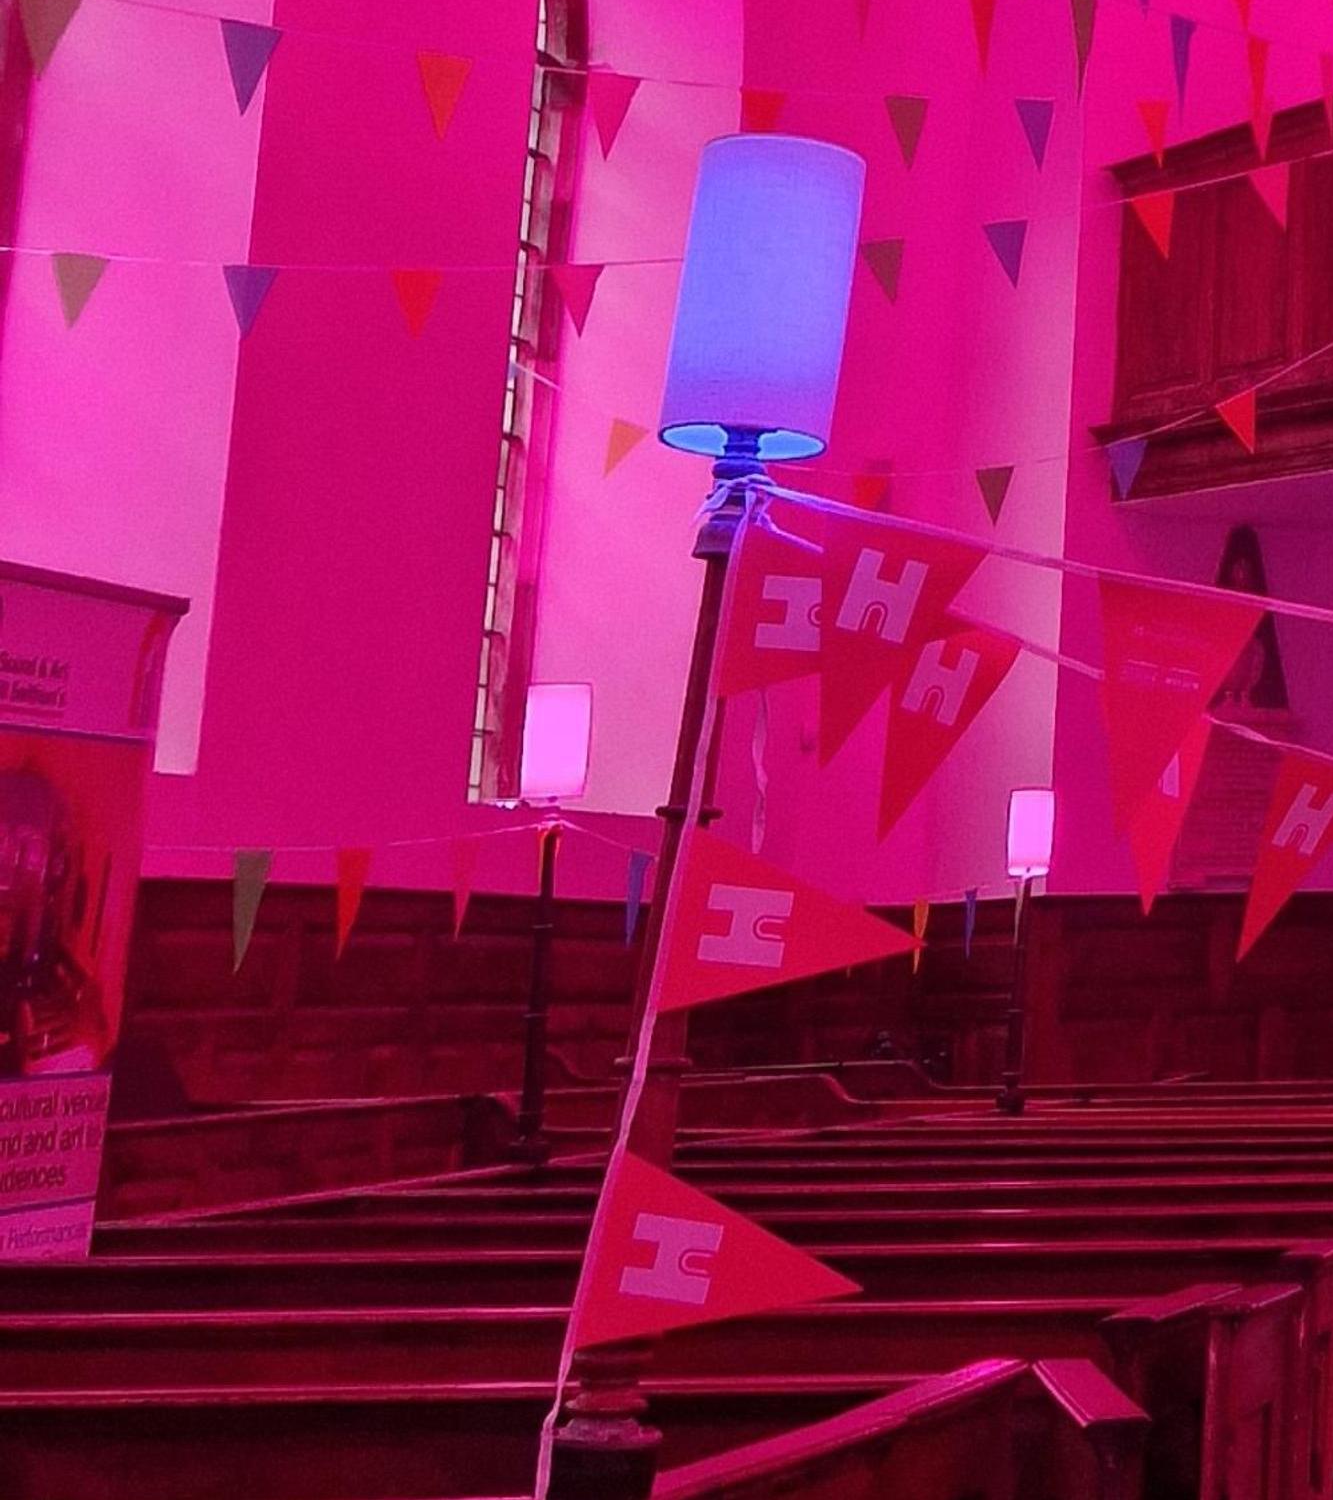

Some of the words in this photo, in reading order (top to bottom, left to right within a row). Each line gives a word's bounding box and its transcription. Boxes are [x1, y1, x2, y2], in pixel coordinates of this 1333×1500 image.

[836, 549, 929, 642] H
[901, 639, 980, 725] H
[697, 883, 794, 968] H
[0, 1089, 60, 1121] cultural
[23, 1122, 58, 1155] and
[619, 1212, 723, 1305] H
